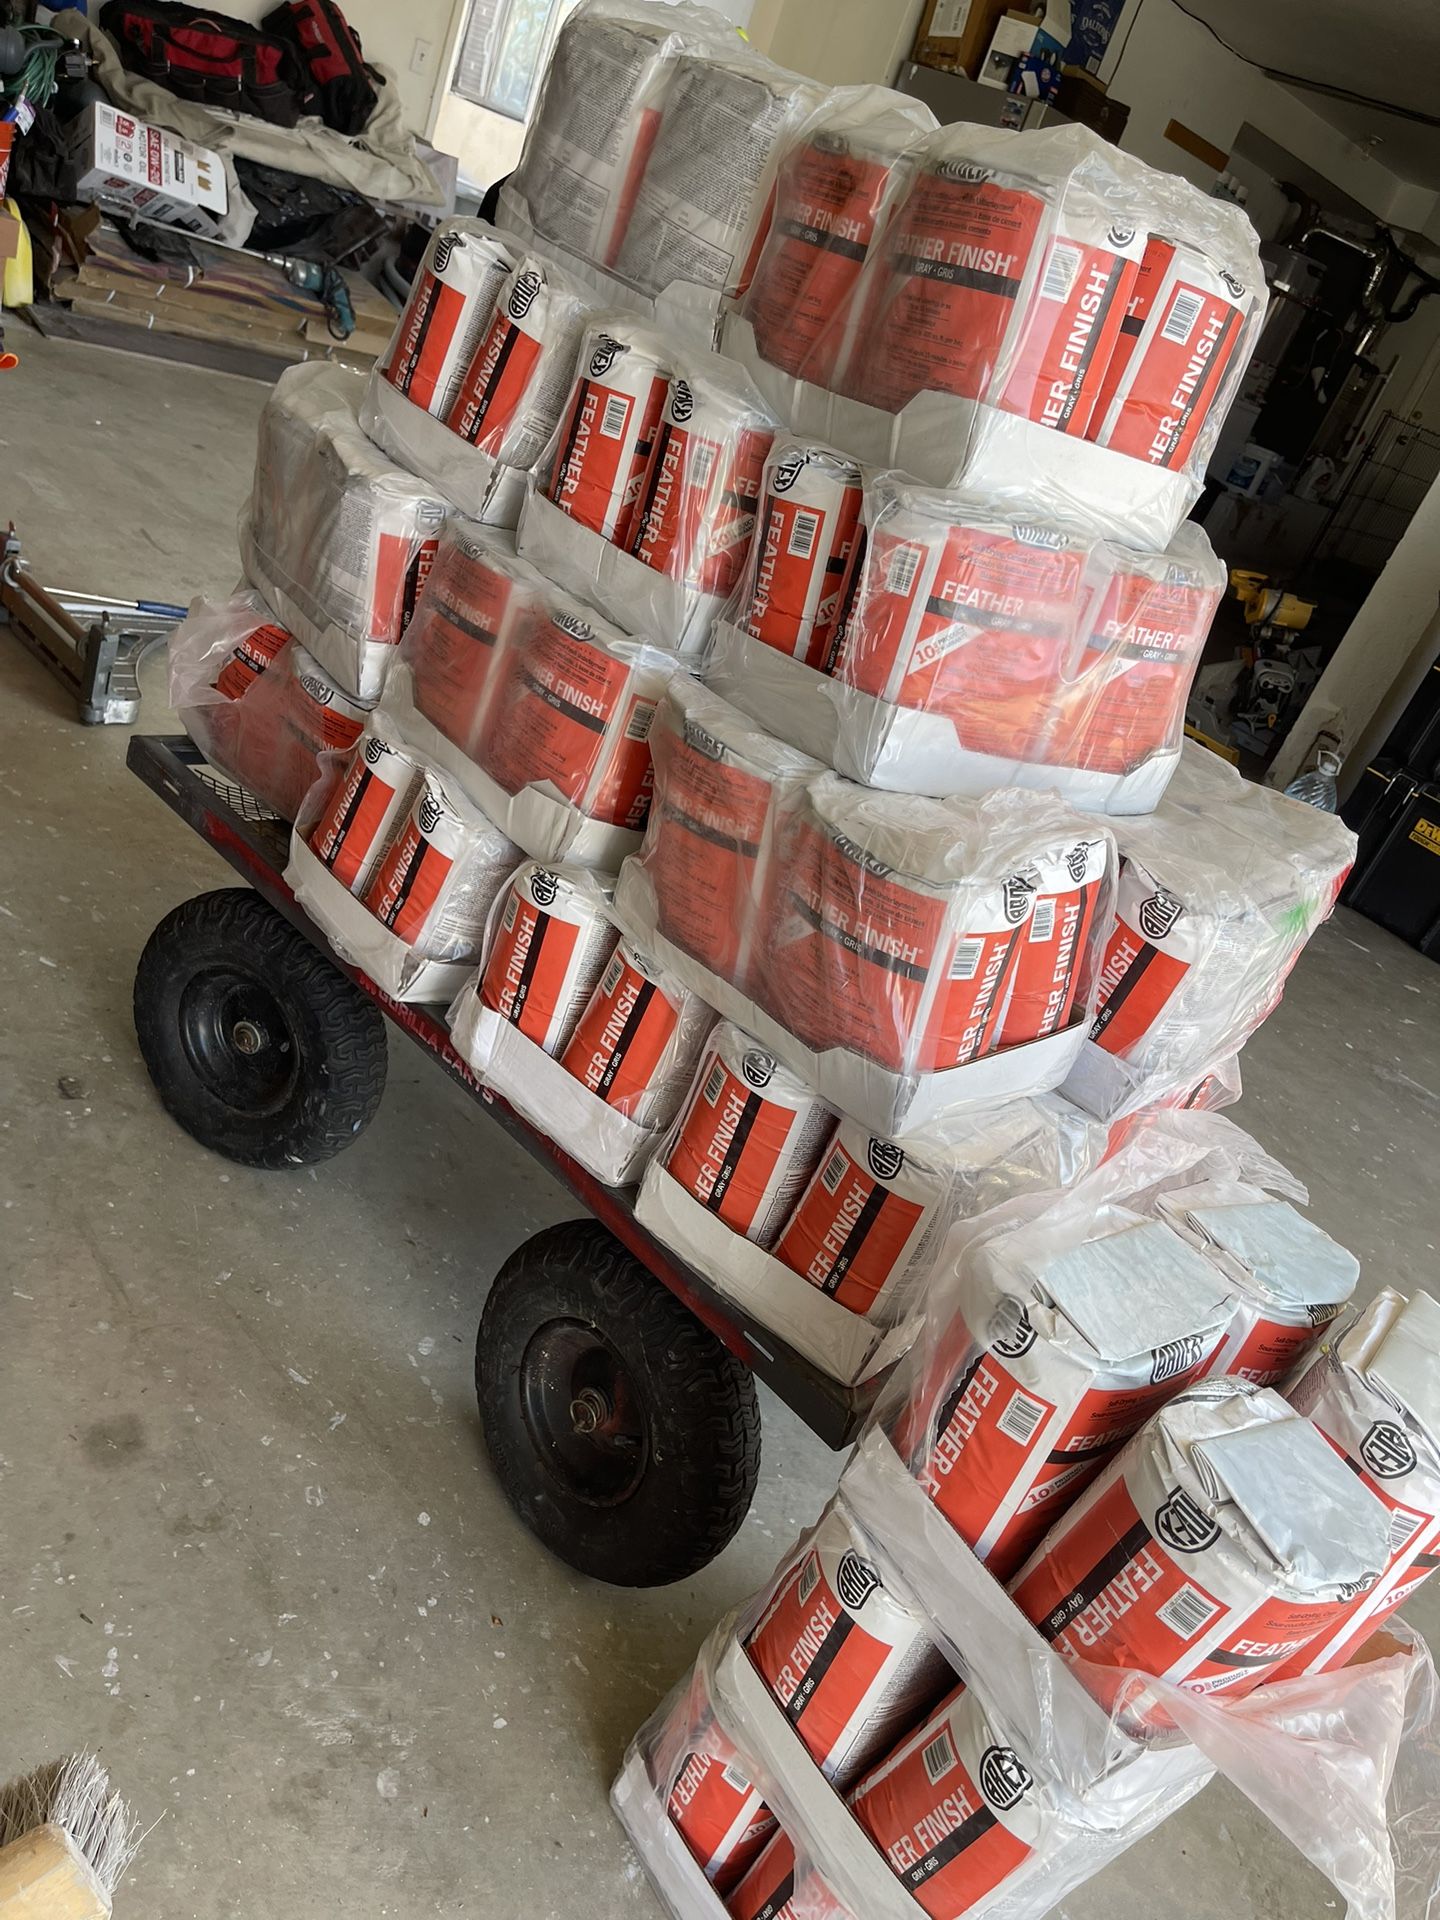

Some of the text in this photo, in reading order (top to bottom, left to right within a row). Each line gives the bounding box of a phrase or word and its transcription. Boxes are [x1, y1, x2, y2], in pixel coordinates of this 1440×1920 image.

[937, 265, 954, 281] GRIS
[1063, 368, 1086, 419] GRAY GRIS
[470, 399, 489, 435] GRAY GRIS
[1167, 406, 1193, 453] GRAY GRIS
[562, 392, 598, 495] FEATHER
[645, 438, 682, 543] FEATHER
[941, 580, 1024, 617] FEATHER
[1101, 620, 1174, 650] FEATHER
[914, 642, 936, 665] 10
[1142, 649, 1160, 661] GRAY
[513, 984, 528, 1019] GRAY GRIS
[1100, 1006, 1113, 1024] GRIS
[377, 990, 439, 1052] GORILLA
[976, 1005, 992, 1048] GRAY GRIS
[603, 1051, 623, 1087] GRAY GRIS
[714, 1164, 733, 1198] GRAY GRIS
[827, 1270, 841, 1290] GRAY
[931, 1364, 999, 1475] FEATHER
[1028, 1485, 1051, 1504] 10
[1073, 1547, 1164, 1648] FEATHER
[1050, 1613, 1068, 1630] GRIS
[793, 1677, 816, 1711] GRAY GRIS
[910, 1856, 940, 1883] GRAY GRIS
